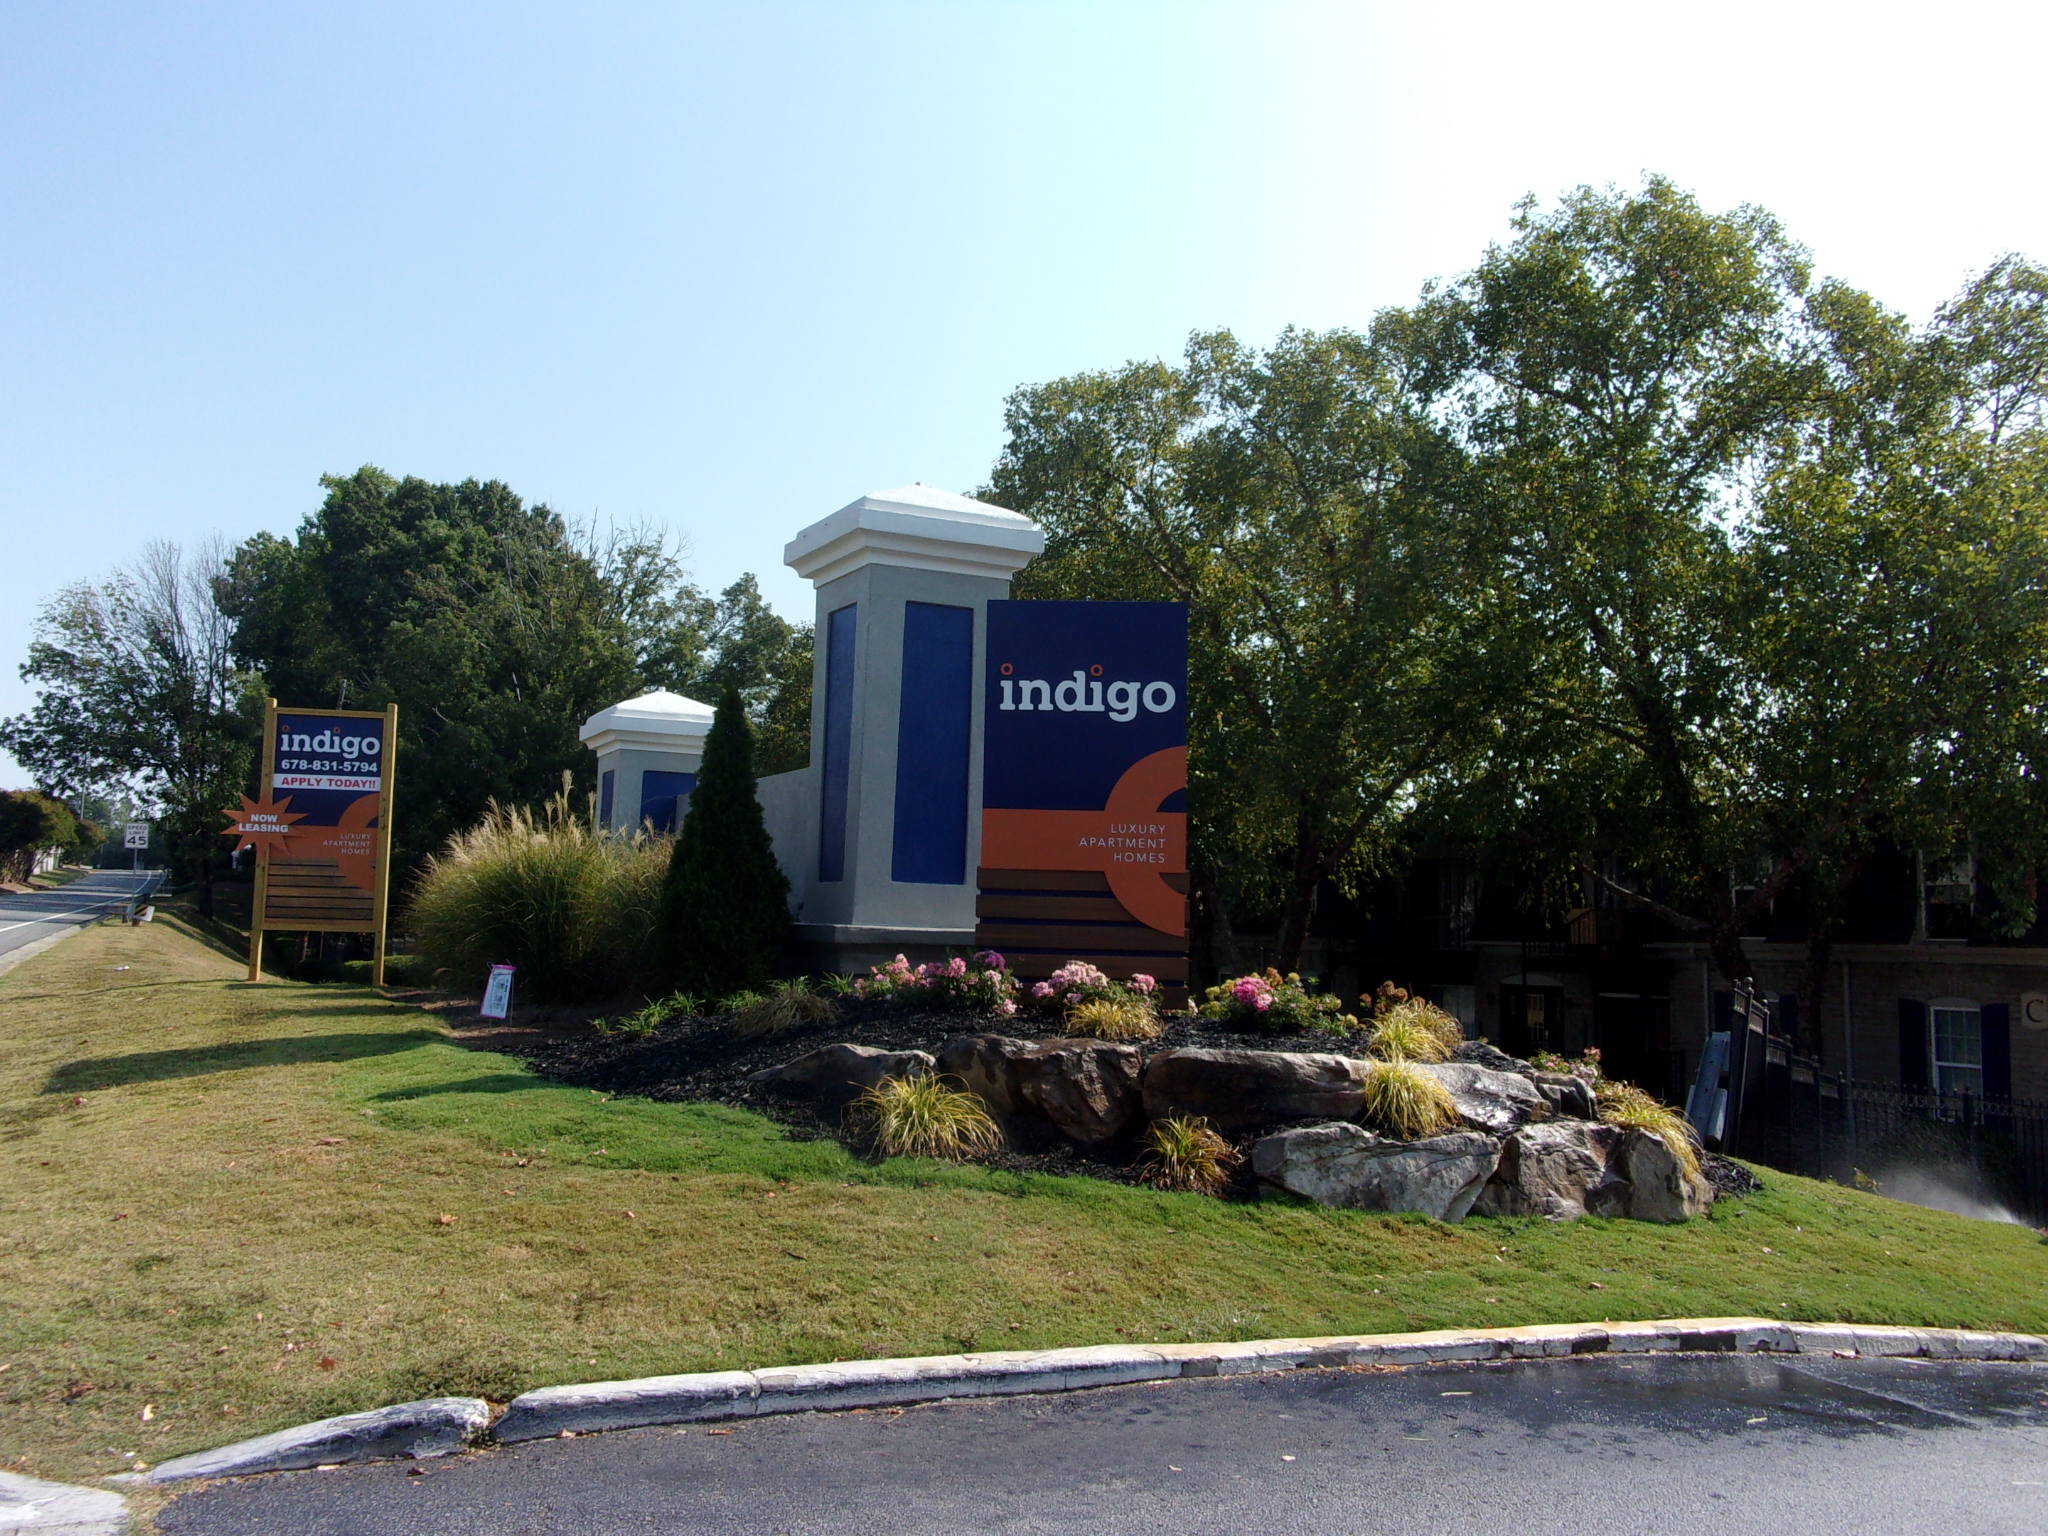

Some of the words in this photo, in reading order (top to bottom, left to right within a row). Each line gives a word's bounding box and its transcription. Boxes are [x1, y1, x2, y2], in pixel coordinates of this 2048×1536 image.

[999, 663, 1177, 723] indigo
[280, 724, 381, 760] indigo
[281, 759, 378, 772] 678-831-5794
[281, 777, 323, 787] APPLY
[326, 778, 377, 789] TODAY!!
[250, 813, 278, 823] NOW
[238, 823, 289, 834] LEASING
[1110, 823, 1166, 835] LUXURY
[127, 836, 147, 845] 45
[322, 840, 371, 848] APARTMENT
[1079, 836, 1167, 849] APARTMENT
[340, 847, 370, 855] HOMES
[1113, 851, 1166, 864] HOMES
